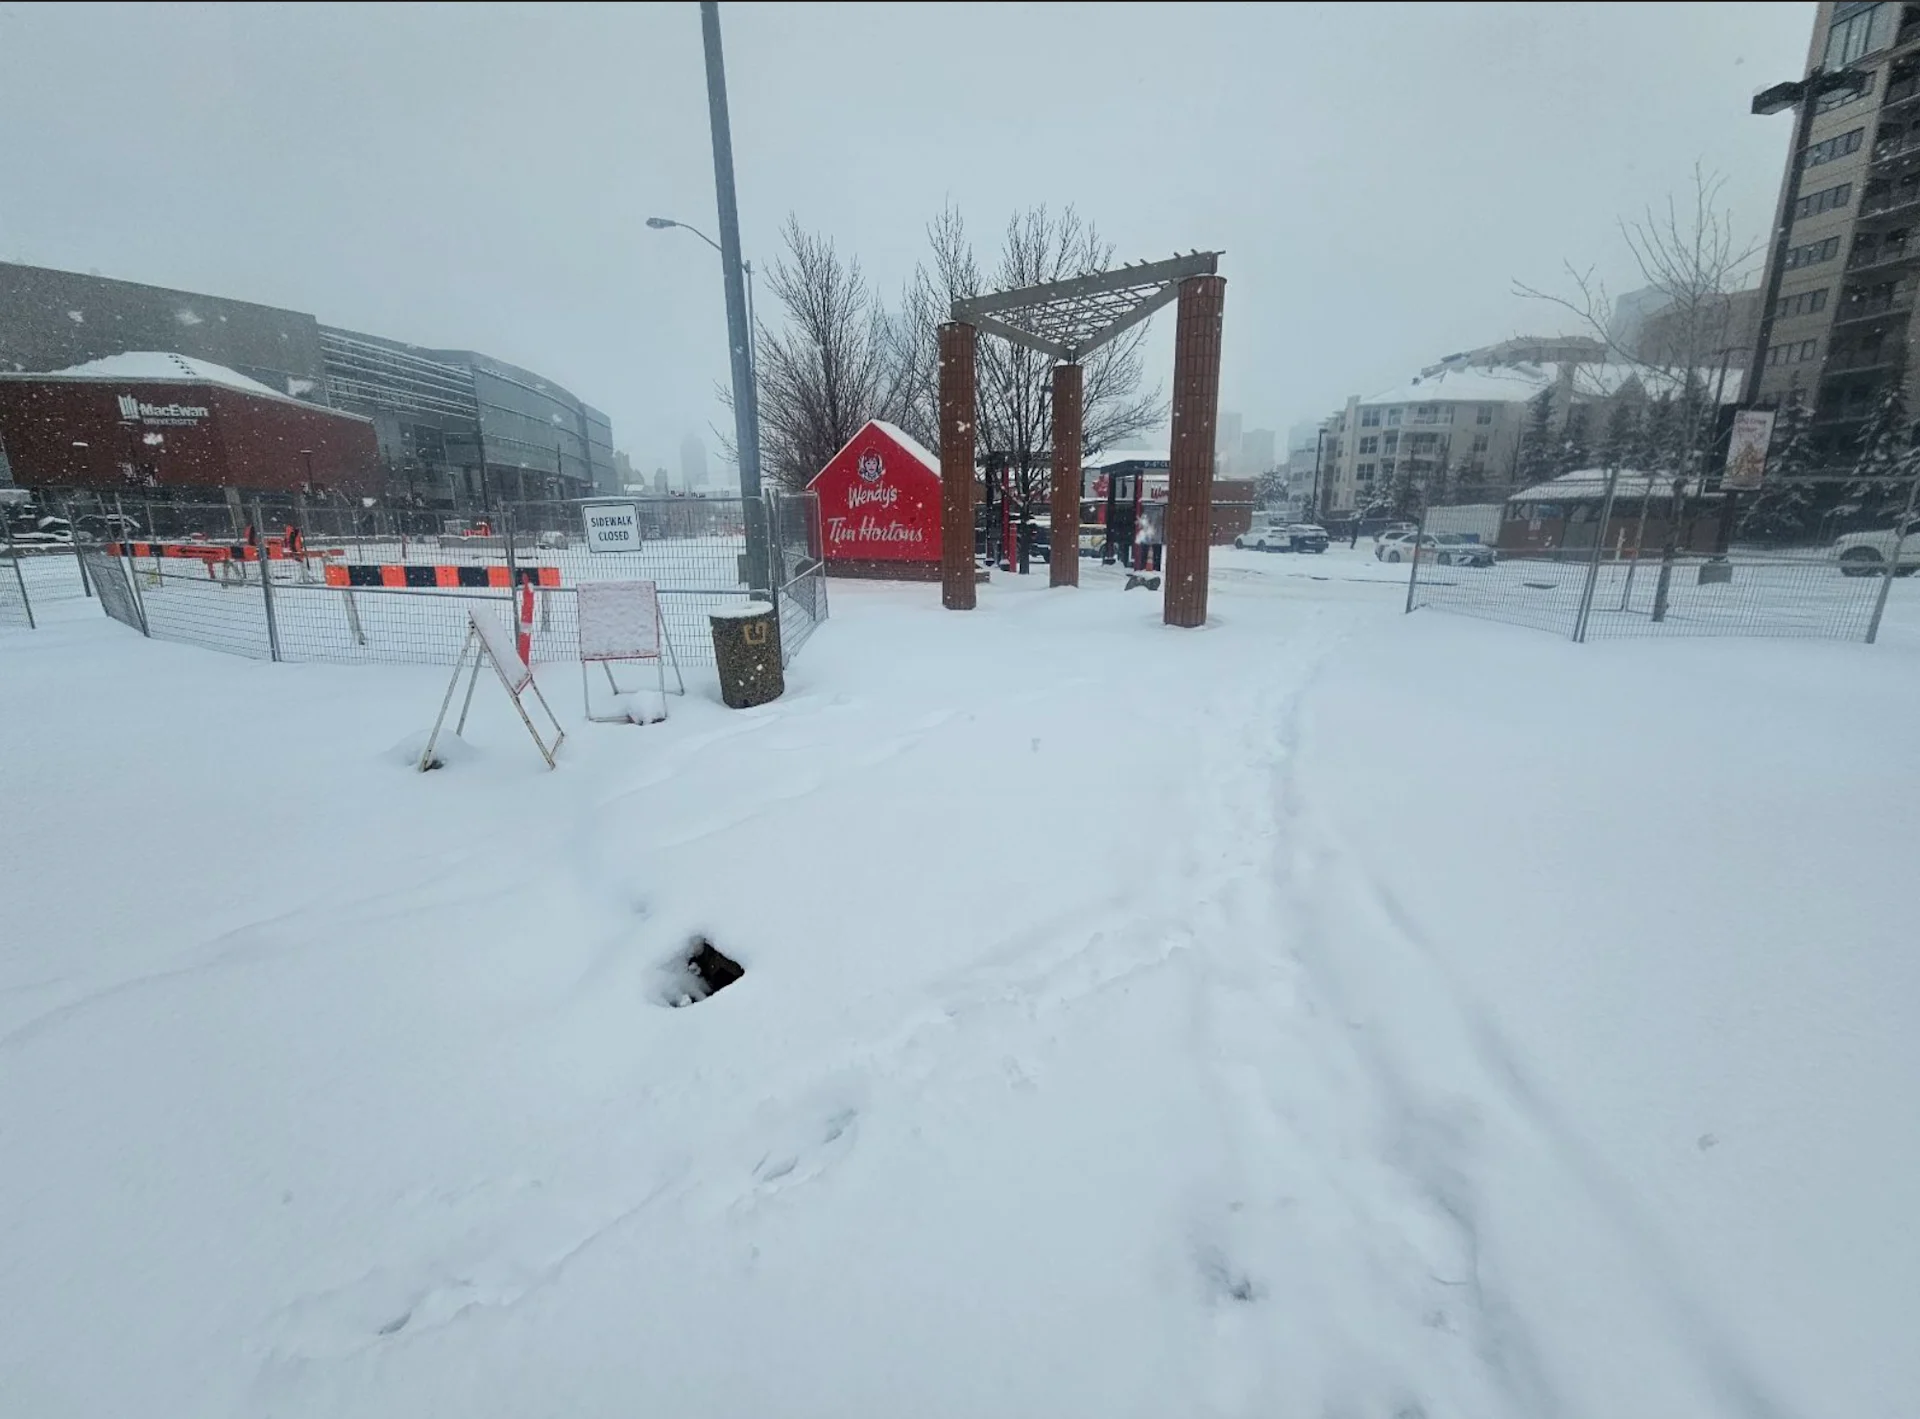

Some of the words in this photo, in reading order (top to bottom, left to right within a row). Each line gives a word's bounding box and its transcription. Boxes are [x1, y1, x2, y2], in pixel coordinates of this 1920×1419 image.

[140, 403, 209, 417] MacEwan
[848, 481, 898, 509] Wendy's
[591, 516, 633, 527] SIDEWALK
[598, 531, 629, 541] CLOSED
[827, 517, 855, 542] Tim
[858, 516, 922, 543] Hortons
